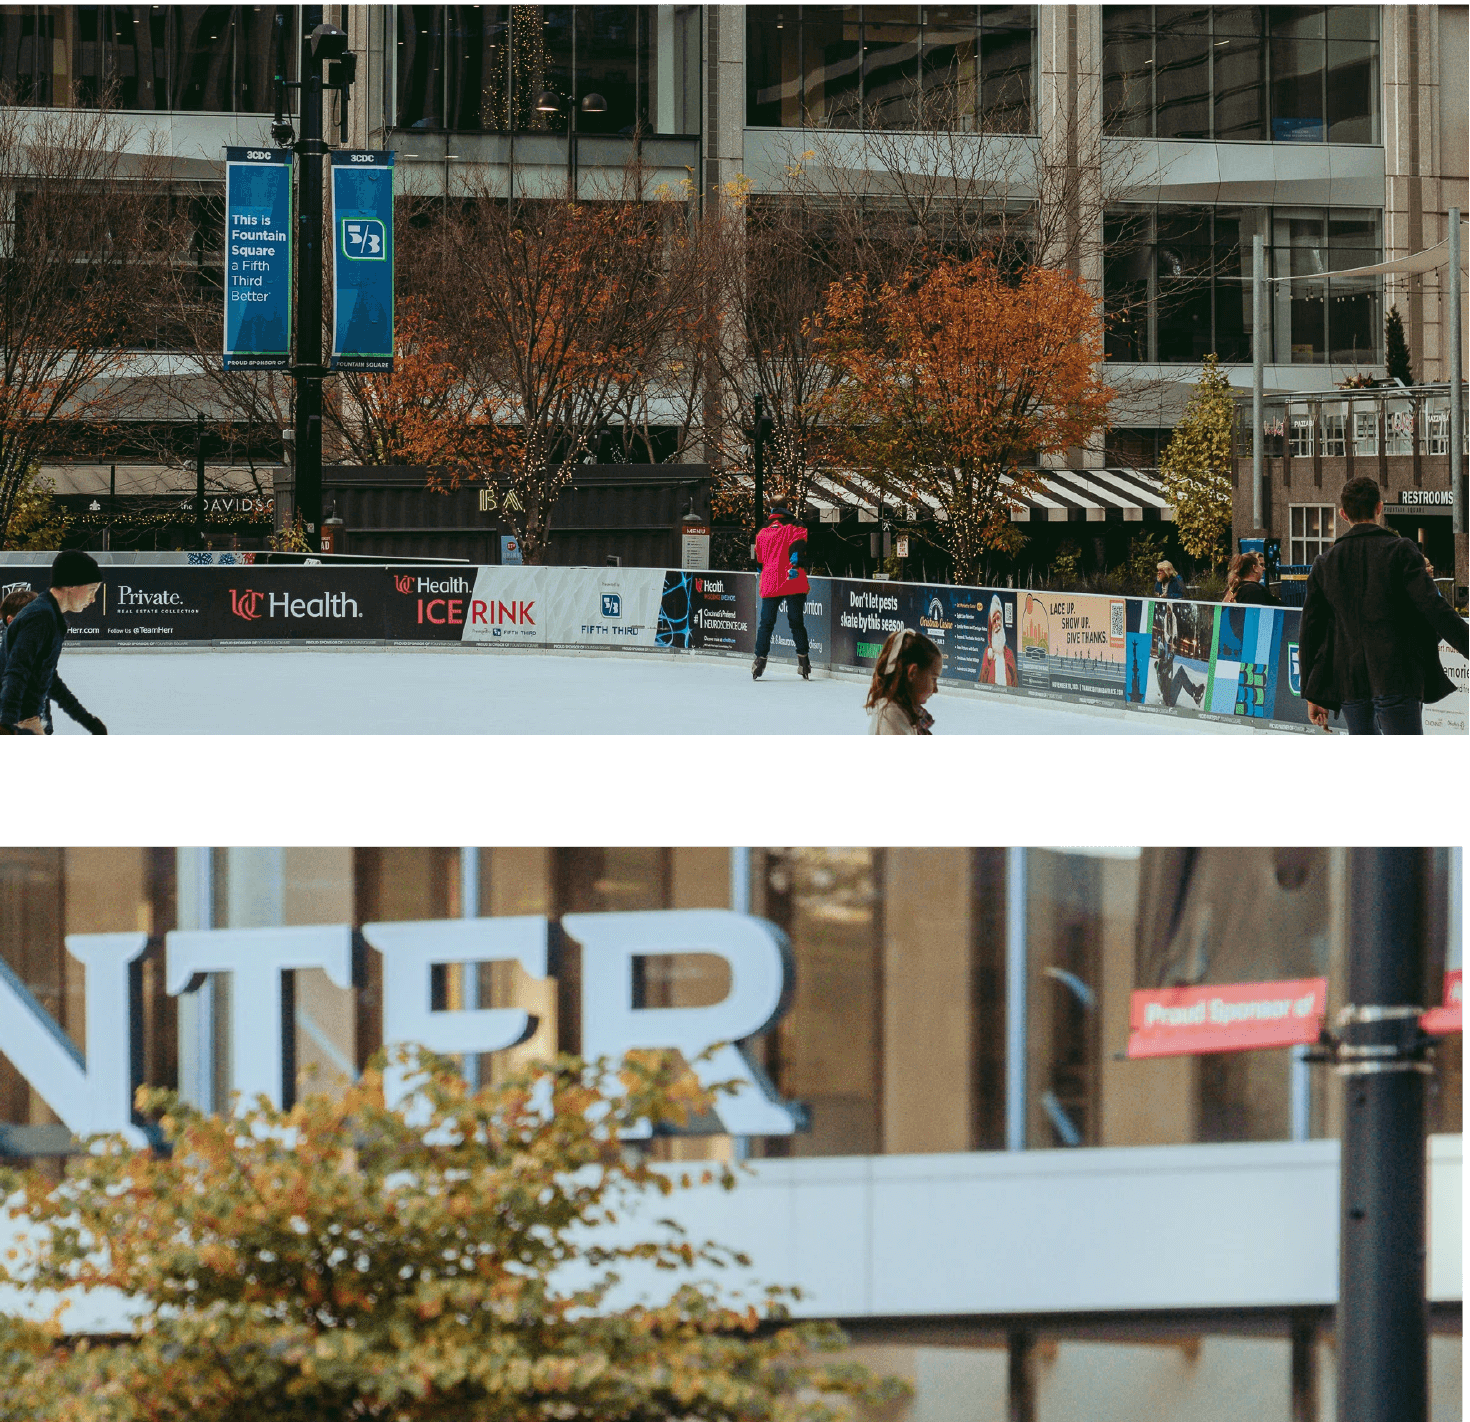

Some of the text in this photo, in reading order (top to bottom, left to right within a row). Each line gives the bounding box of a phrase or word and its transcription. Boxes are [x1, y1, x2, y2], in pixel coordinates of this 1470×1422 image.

[246, 151, 272, 160] 3CDC
[350, 154, 375, 163] 3CDC
[232, 214, 271, 225] This is
[232, 230, 286, 242] Fountain
[231, 245, 275, 258] Square
[231, 260, 270, 272] a Fifth
[232, 275, 263, 287] Third
[231, 290, 268, 302] Better
[1402, 490, 1454, 505] RESTROOMS
[117, 585, 184, 605] Private.
[849, 591, 898, 613] Don't let pests
[417, 599, 536, 625] ICE RINK
[1050, 603, 1076, 615] LACE UP.
[840, 611, 859, 629] skate
[859, 612, 868, 633] by
[868, 612, 881, 631] this
[1062, 617, 1091, 629] SHOW UP.
[133, 626, 174, 635] @TeamHerr
[581, 625, 639, 635] FIFTH THIRD
[1067, 631, 1108, 644] GIVE THANKS.
[1145, 992, 1316, 1025] Proud Sponsor of
